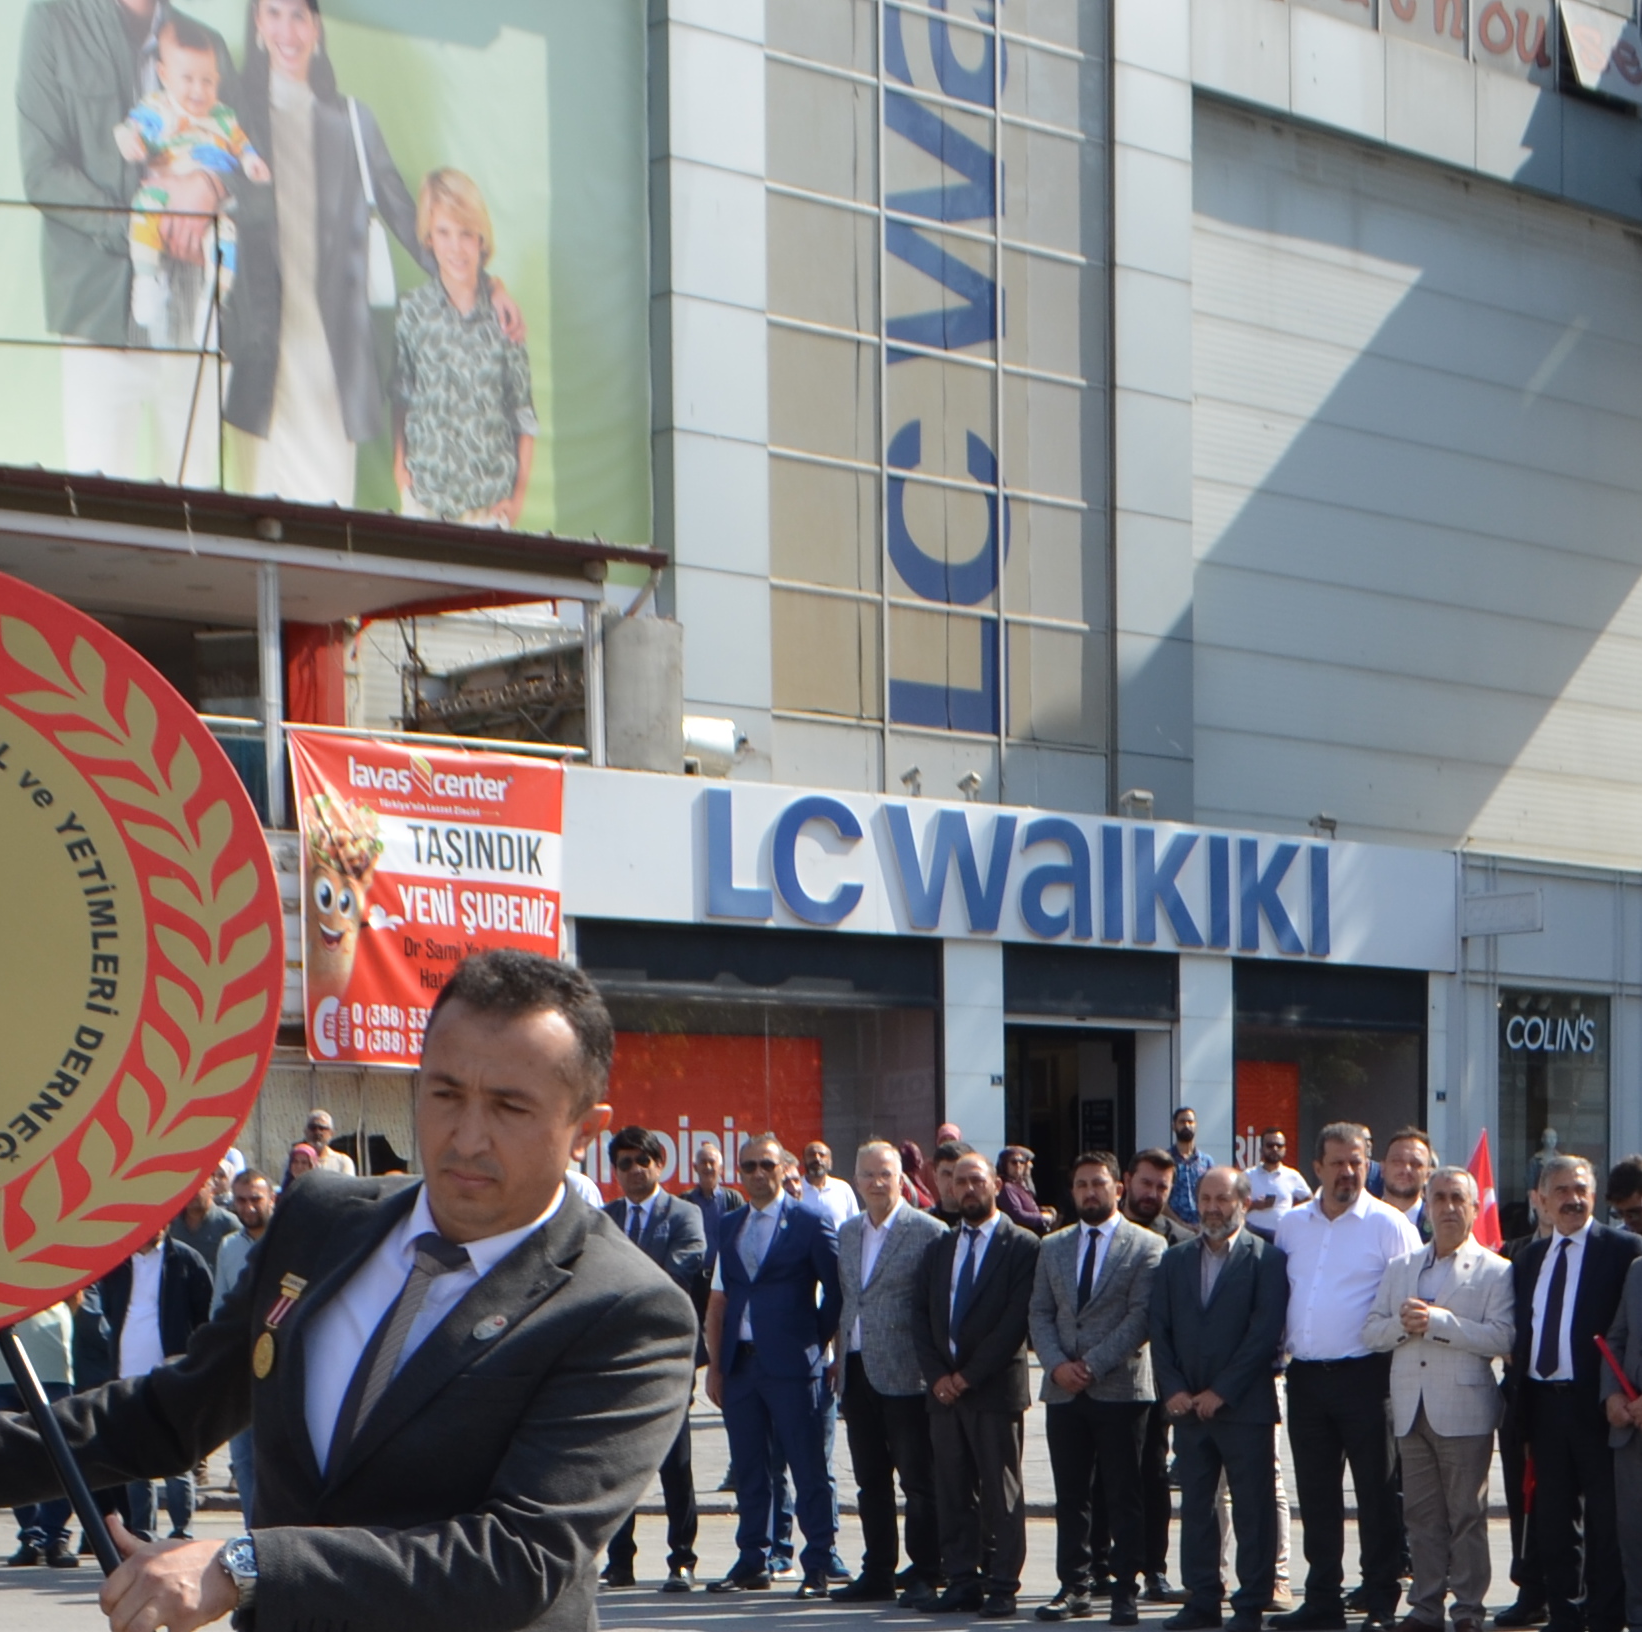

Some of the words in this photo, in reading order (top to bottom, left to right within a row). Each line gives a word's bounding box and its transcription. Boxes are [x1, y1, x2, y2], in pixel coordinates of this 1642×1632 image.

[347, 755, 412, 794] lavaş
[407, 823, 544, 876] TAŞINDIK
[702, 787, 864, 925] LC
[17, 769, 55, 809] ve
[54, 811, 121, 1017] YETİMLERİ
[397, 882, 456, 927] YENİ
[460, 890, 556, 938] ŞUBEMİZ
[404, 937, 421, 957] Dr
[425, 938, 462, 961] Sami
[351, 1002, 363, 1025] 0
[365, 1004, 405, 1031] (388)
[1505, 1012, 1596, 1054] COLIN'S
[353, 1027, 365, 1051] 0
[367, 1029, 406, 1057] (388)
